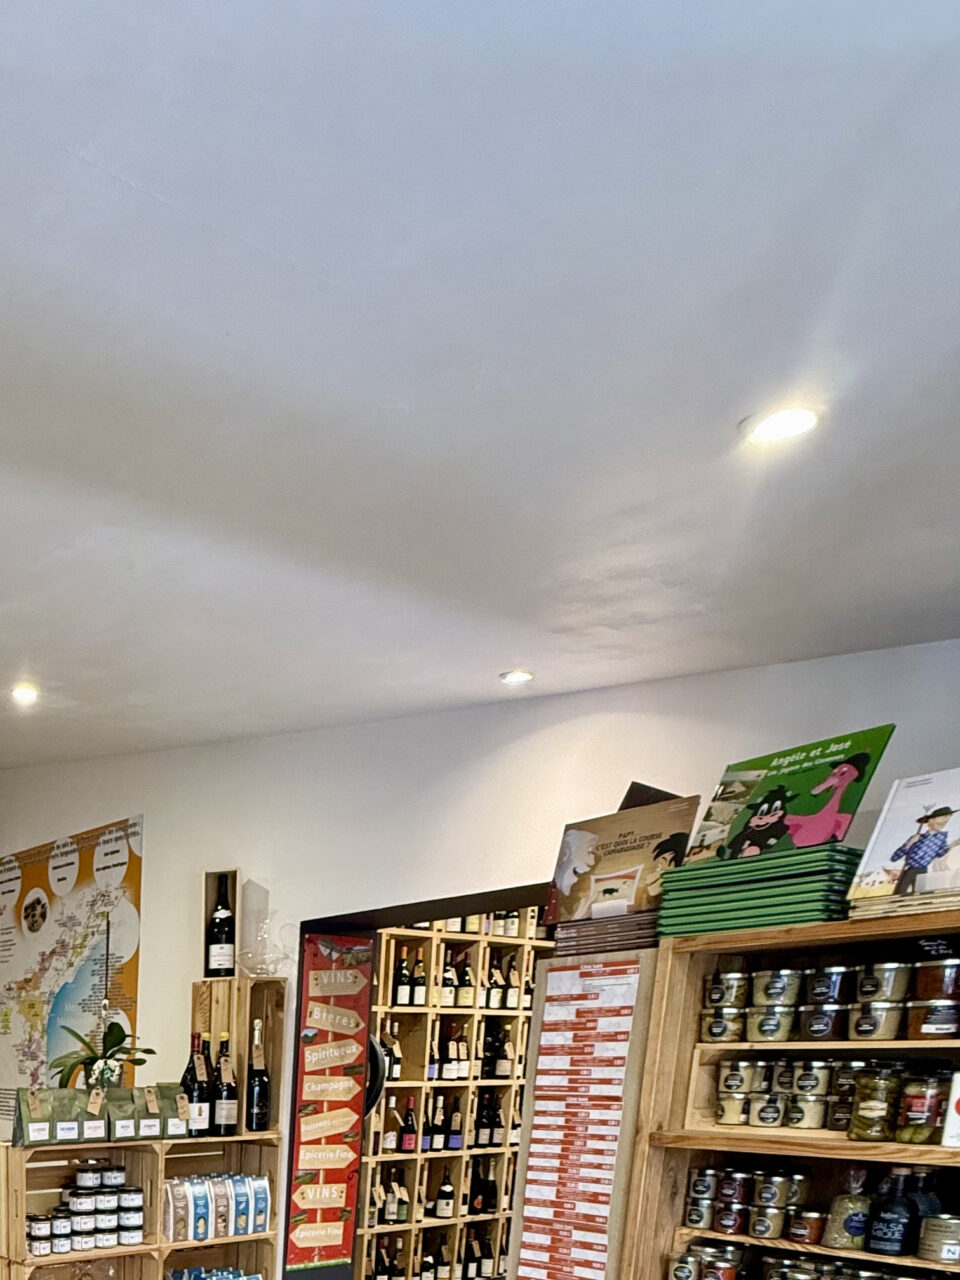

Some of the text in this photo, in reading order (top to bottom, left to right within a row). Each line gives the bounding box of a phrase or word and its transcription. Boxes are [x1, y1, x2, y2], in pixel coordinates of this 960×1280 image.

[809, 746, 823, 758] et
[321, 971, 354, 984] VINS
[313, 1006, 355, 1027] Bières
[305, 1044, 358, 1063] Spiritueux
[307, 1187, 338, 1199] VINS
